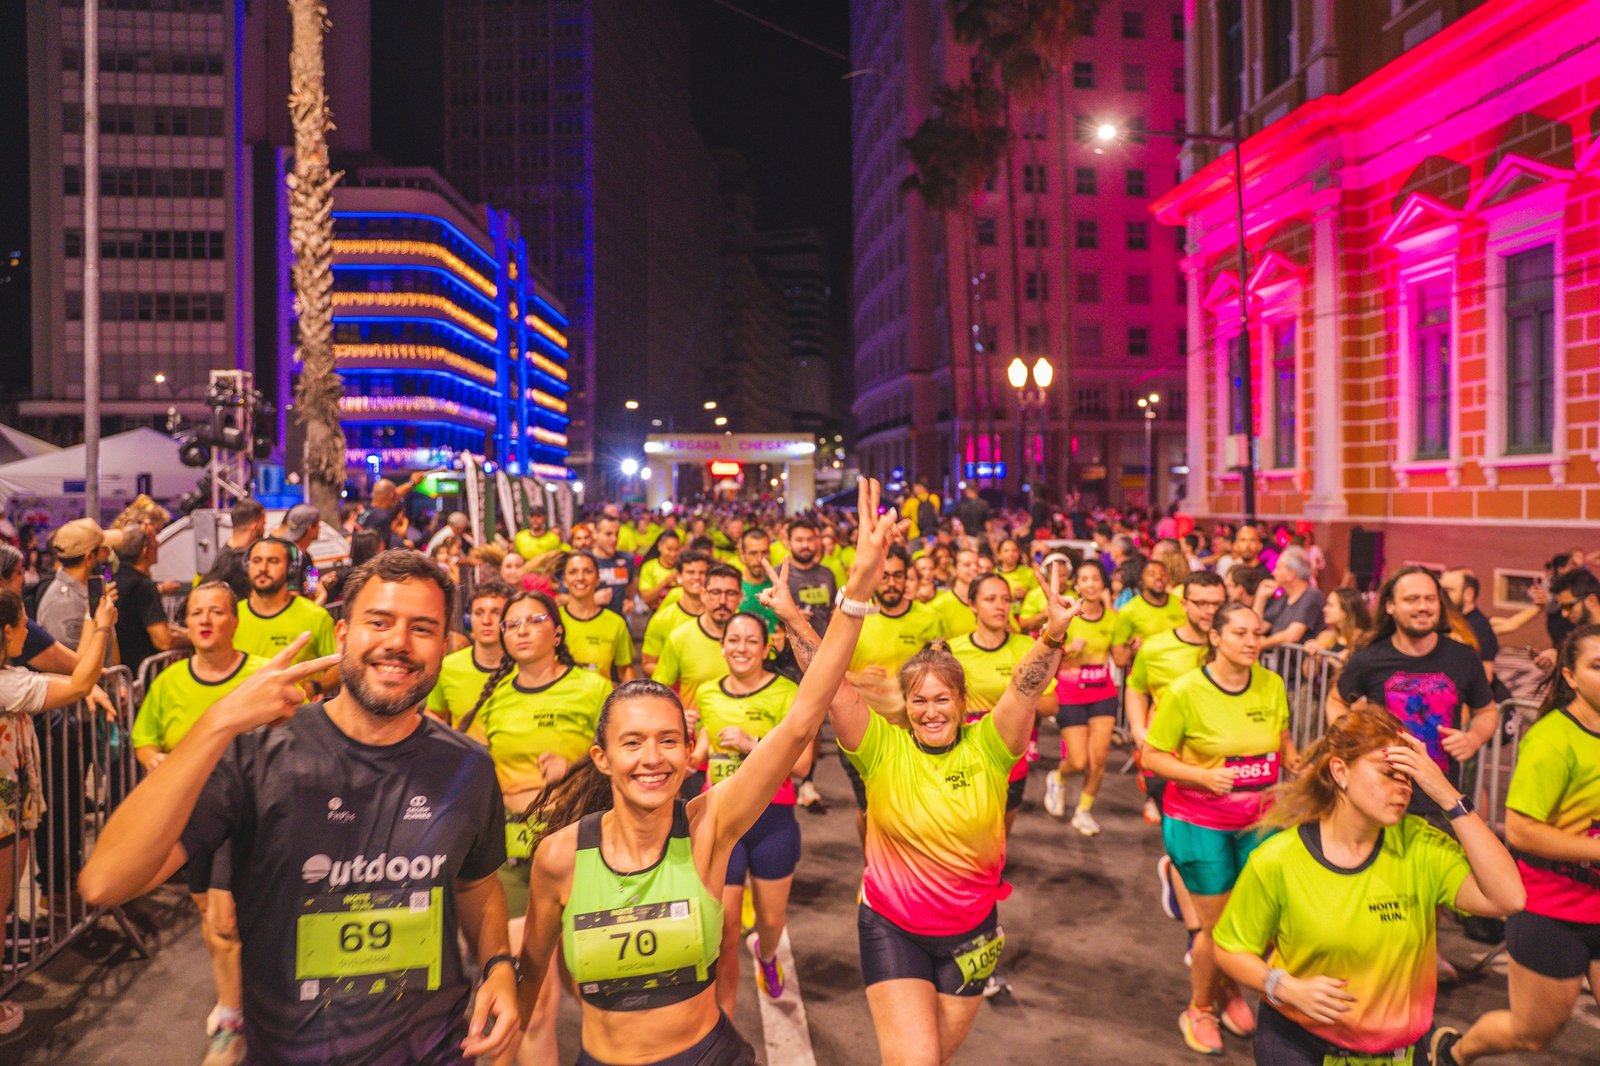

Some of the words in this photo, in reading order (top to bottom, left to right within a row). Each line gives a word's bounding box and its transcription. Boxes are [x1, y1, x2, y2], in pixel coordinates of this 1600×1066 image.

[661, 440, 721, 450] ARGADA
[714, 763, 742, 778] 18
[1231, 762, 1272, 780] 2661
[1368, 901, 1400, 912] NOITE
[338, 919, 393, 953] 69
[610, 929, 657, 960] 70
